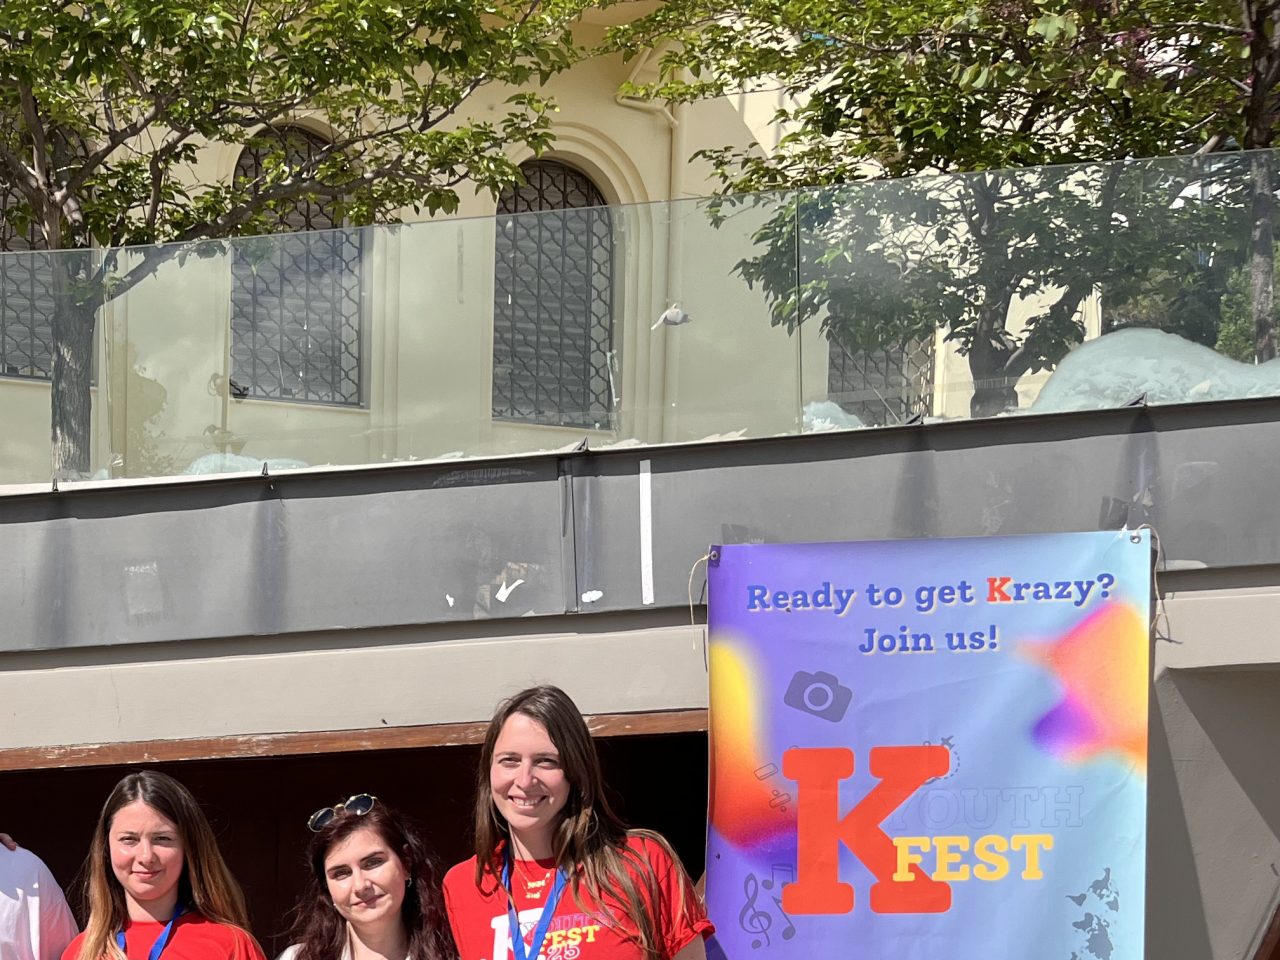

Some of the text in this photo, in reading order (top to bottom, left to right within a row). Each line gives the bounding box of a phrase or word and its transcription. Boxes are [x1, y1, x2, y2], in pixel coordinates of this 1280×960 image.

[746, 573, 1117, 615] Ready to get Krazy?
[858, 624, 1000, 655] Join us!
[782, 745, 952, 915] K
[892, 834, 1055, 882] FEST
